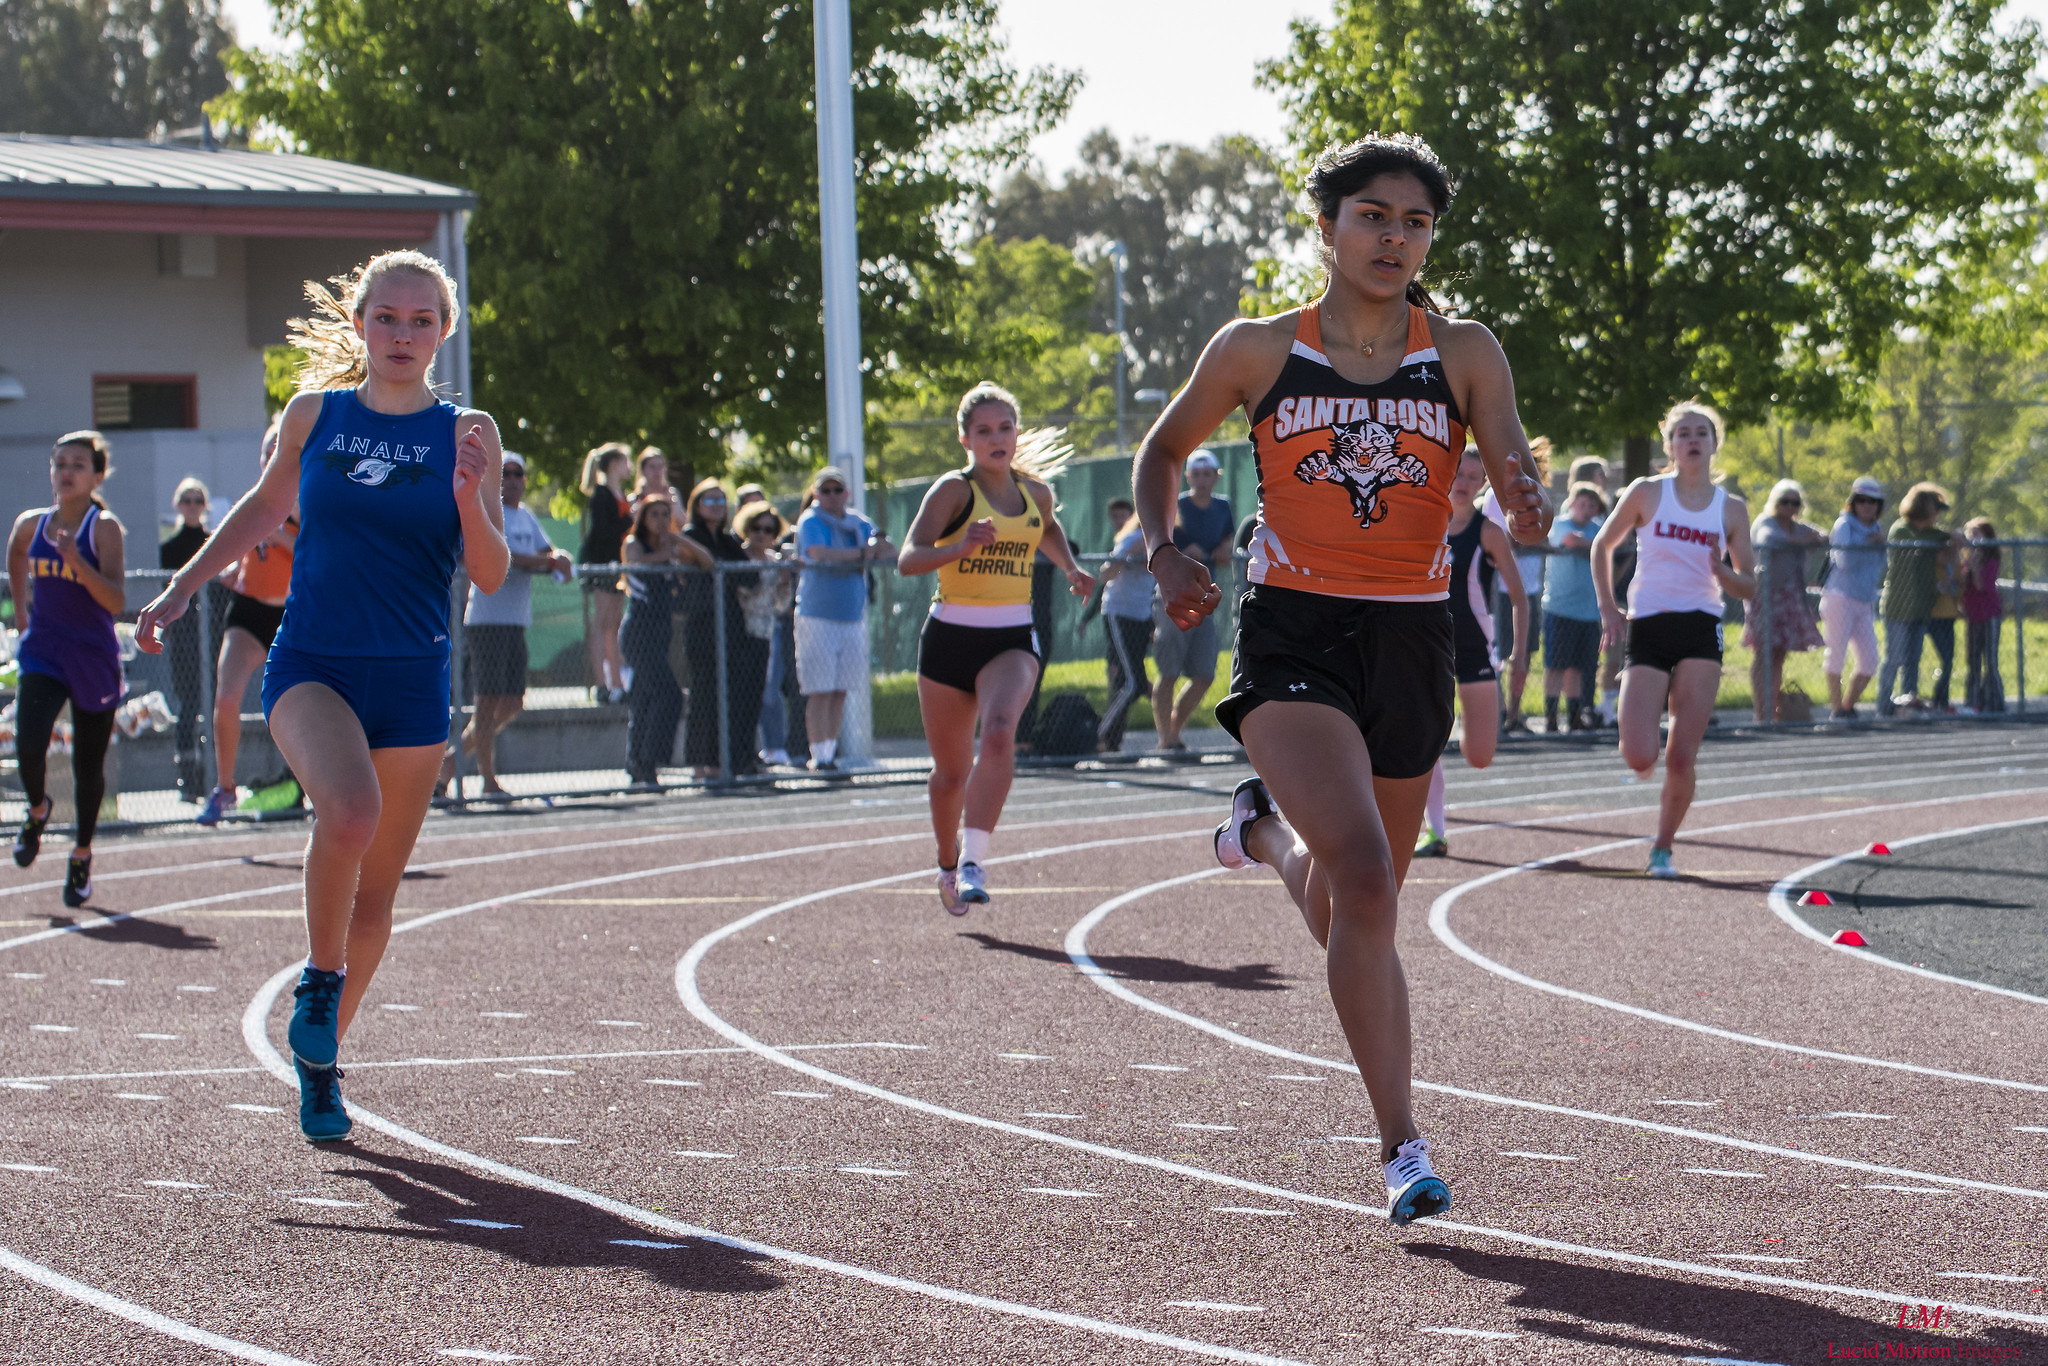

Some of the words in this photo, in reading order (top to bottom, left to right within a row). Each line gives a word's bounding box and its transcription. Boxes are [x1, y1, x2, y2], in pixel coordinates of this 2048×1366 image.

[1275, 396, 1370, 438] SANTA
[1378, 397, 1450, 448] ROSA
[327, 433, 430, 462] ANALY
[981, 541, 1029, 559] MARIA
